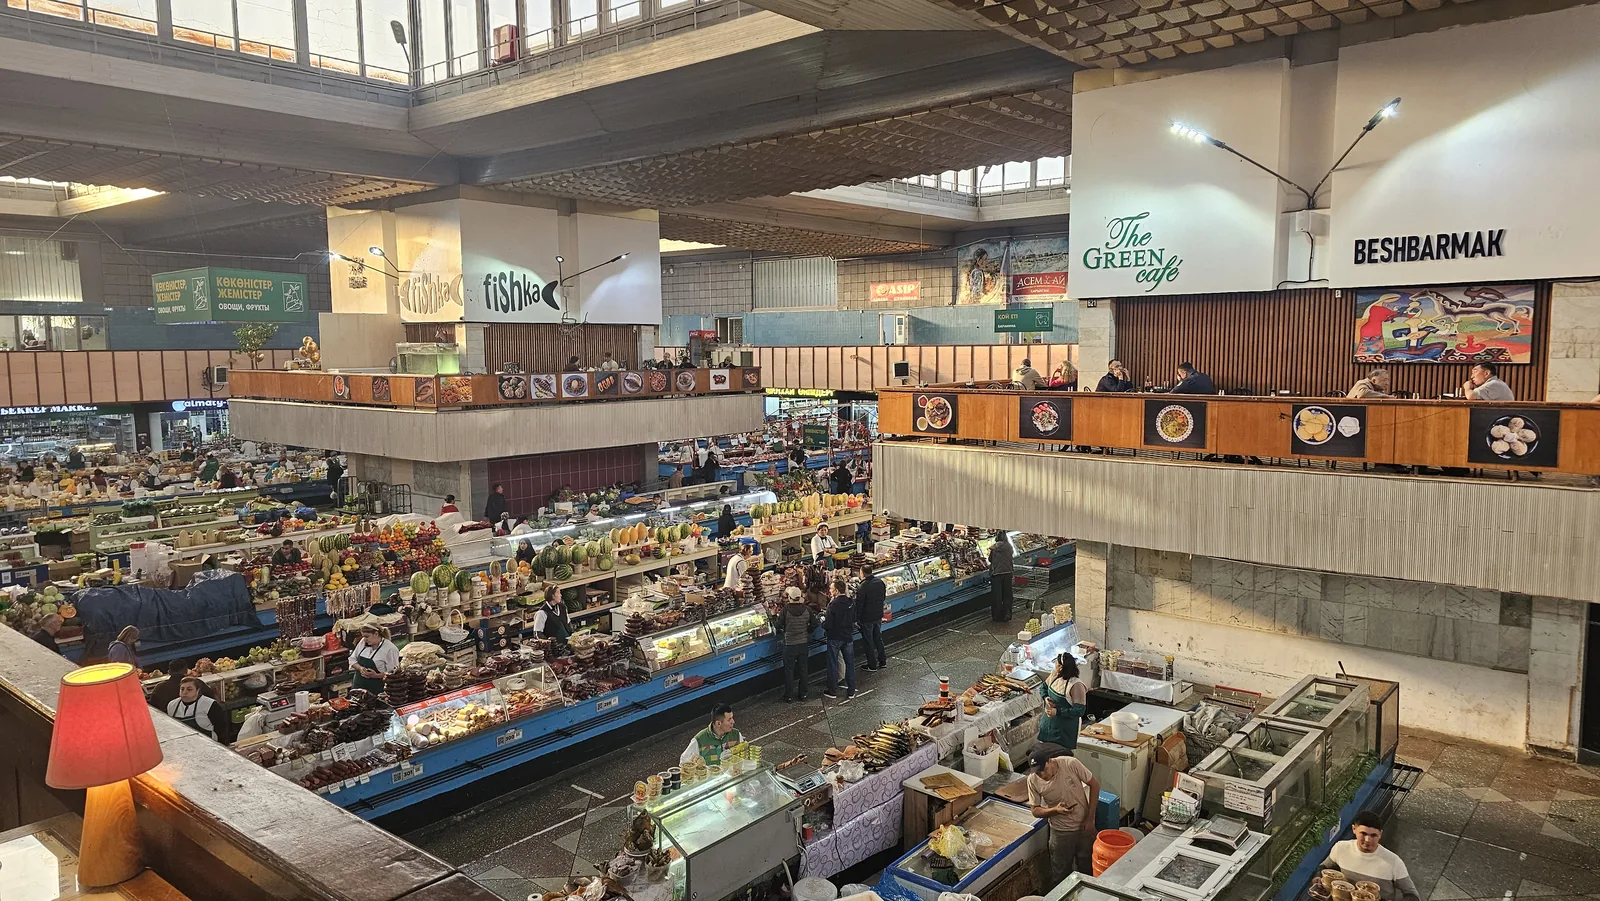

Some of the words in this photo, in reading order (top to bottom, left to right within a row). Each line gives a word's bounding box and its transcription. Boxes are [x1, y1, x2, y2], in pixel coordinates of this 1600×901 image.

[1105, 211, 1153, 250] The
[1354, 229, 1504, 265] BESHBARMAK
[1083, 247, 1165, 270] GREEN
[1135, 255, 1184, 293] café
[155, 279, 187, 292] КӨКӨНІСТЕР,
[216, 276, 274, 292] КӨКӨНІСТЕР,
[889, 284, 915, 295] ASIP
[156, 291, 181, 303] ЖЕМІСТЕР
[217, 288, 263, 300] ЖЕМІСТЕР
[157, 306, 171, 314] ОВОЩИ,
[218, 302, 245, 312] ОВОЩИ,
[245, 303, 270, 312] ФРУКТЫ
[184, 400, 229, 408] almaty-
